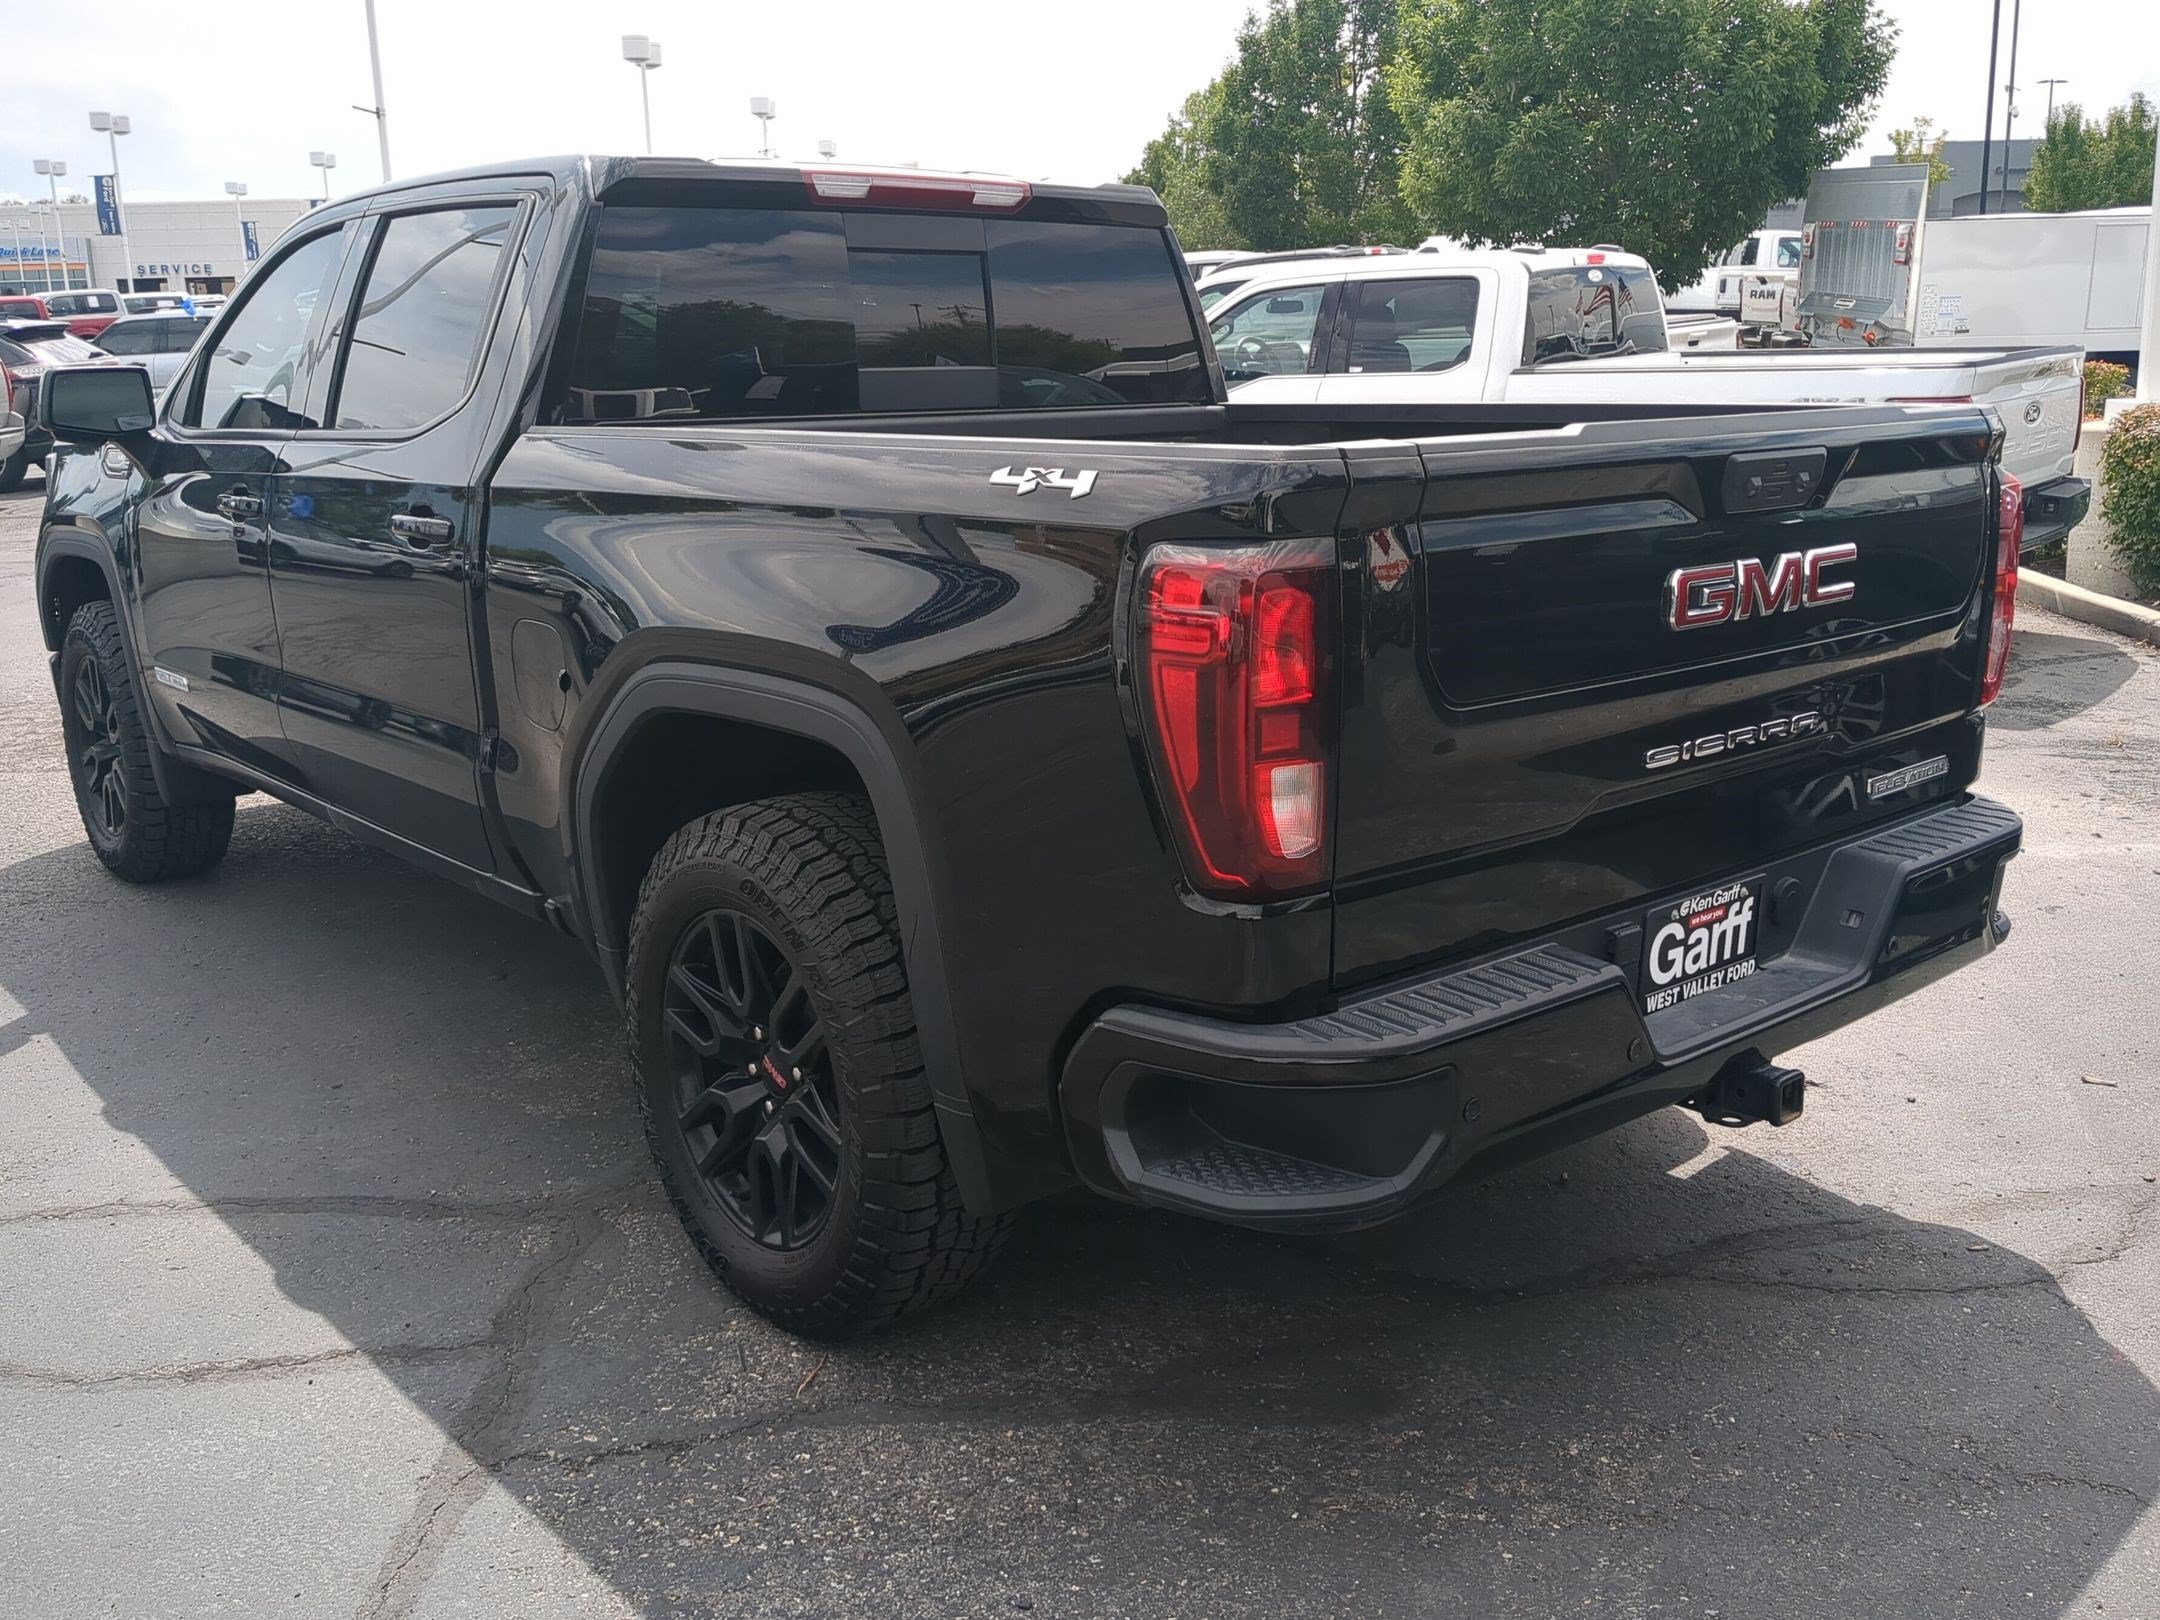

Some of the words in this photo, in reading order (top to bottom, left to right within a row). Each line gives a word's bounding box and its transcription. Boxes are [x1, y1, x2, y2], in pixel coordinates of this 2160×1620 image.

[0, 247, 30, 258] uik
[137, 263, 213, 275] SERVICE
[1750, 289, 1776, 300] RAM
[1669, 542, 1857, 631] GMC
[1646, 711, 1821, 769] SIERRA
[1690, 896, 1712, 914] Ken
[1713, 884, 1741, 906] Garff
[1700, 911, 1713, 921] hear
[1712, 908, 1724, 919] you
[1650, 896, 1754, 985] Garff
[1647, 986, 1680, 1013] WEST
[1683, 970, 1725, 1000] VALLEY
[1726, 959, 1755, 983] FORD
